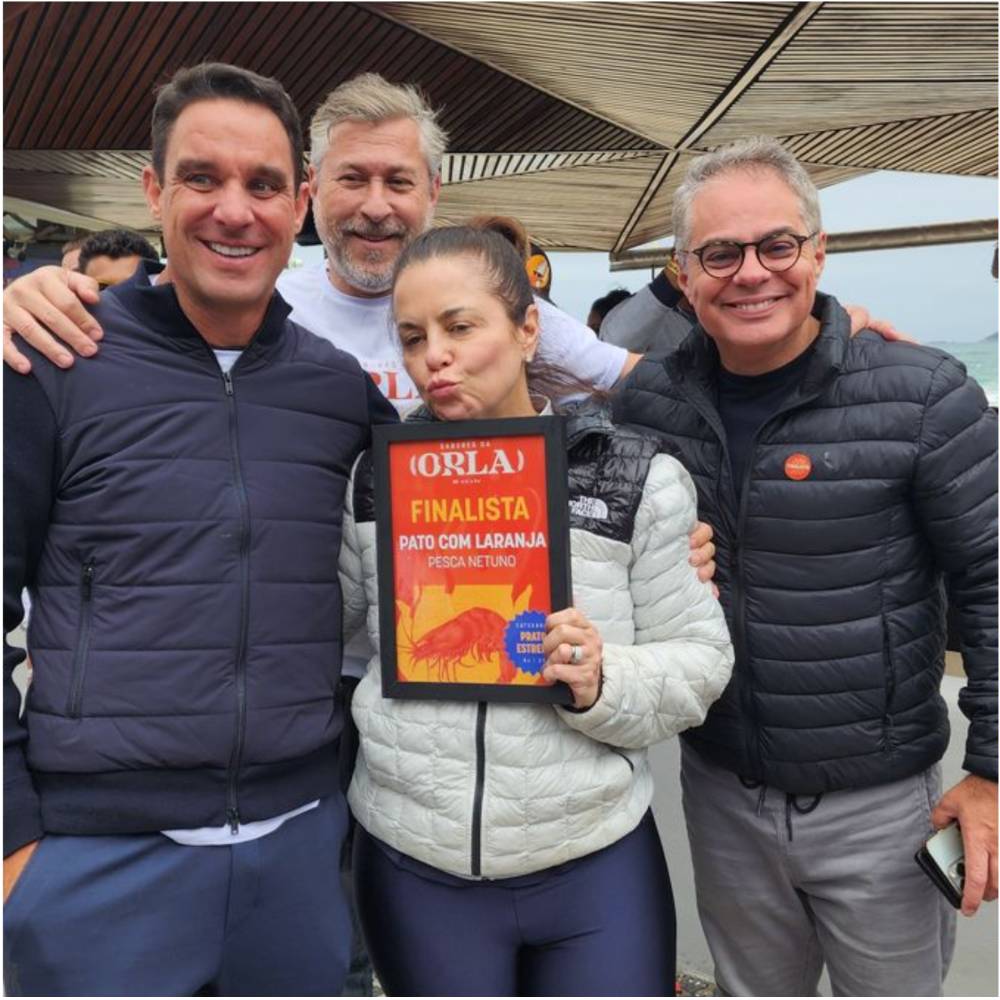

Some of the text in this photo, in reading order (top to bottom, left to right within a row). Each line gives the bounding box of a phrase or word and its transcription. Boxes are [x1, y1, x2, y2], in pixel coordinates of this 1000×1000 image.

[411, 496, 530, 523] FINALISTA
[399, 531, 547, 550] PATO COM LARANJA
[428, 554, 516, 569] PESCA NETUNO
